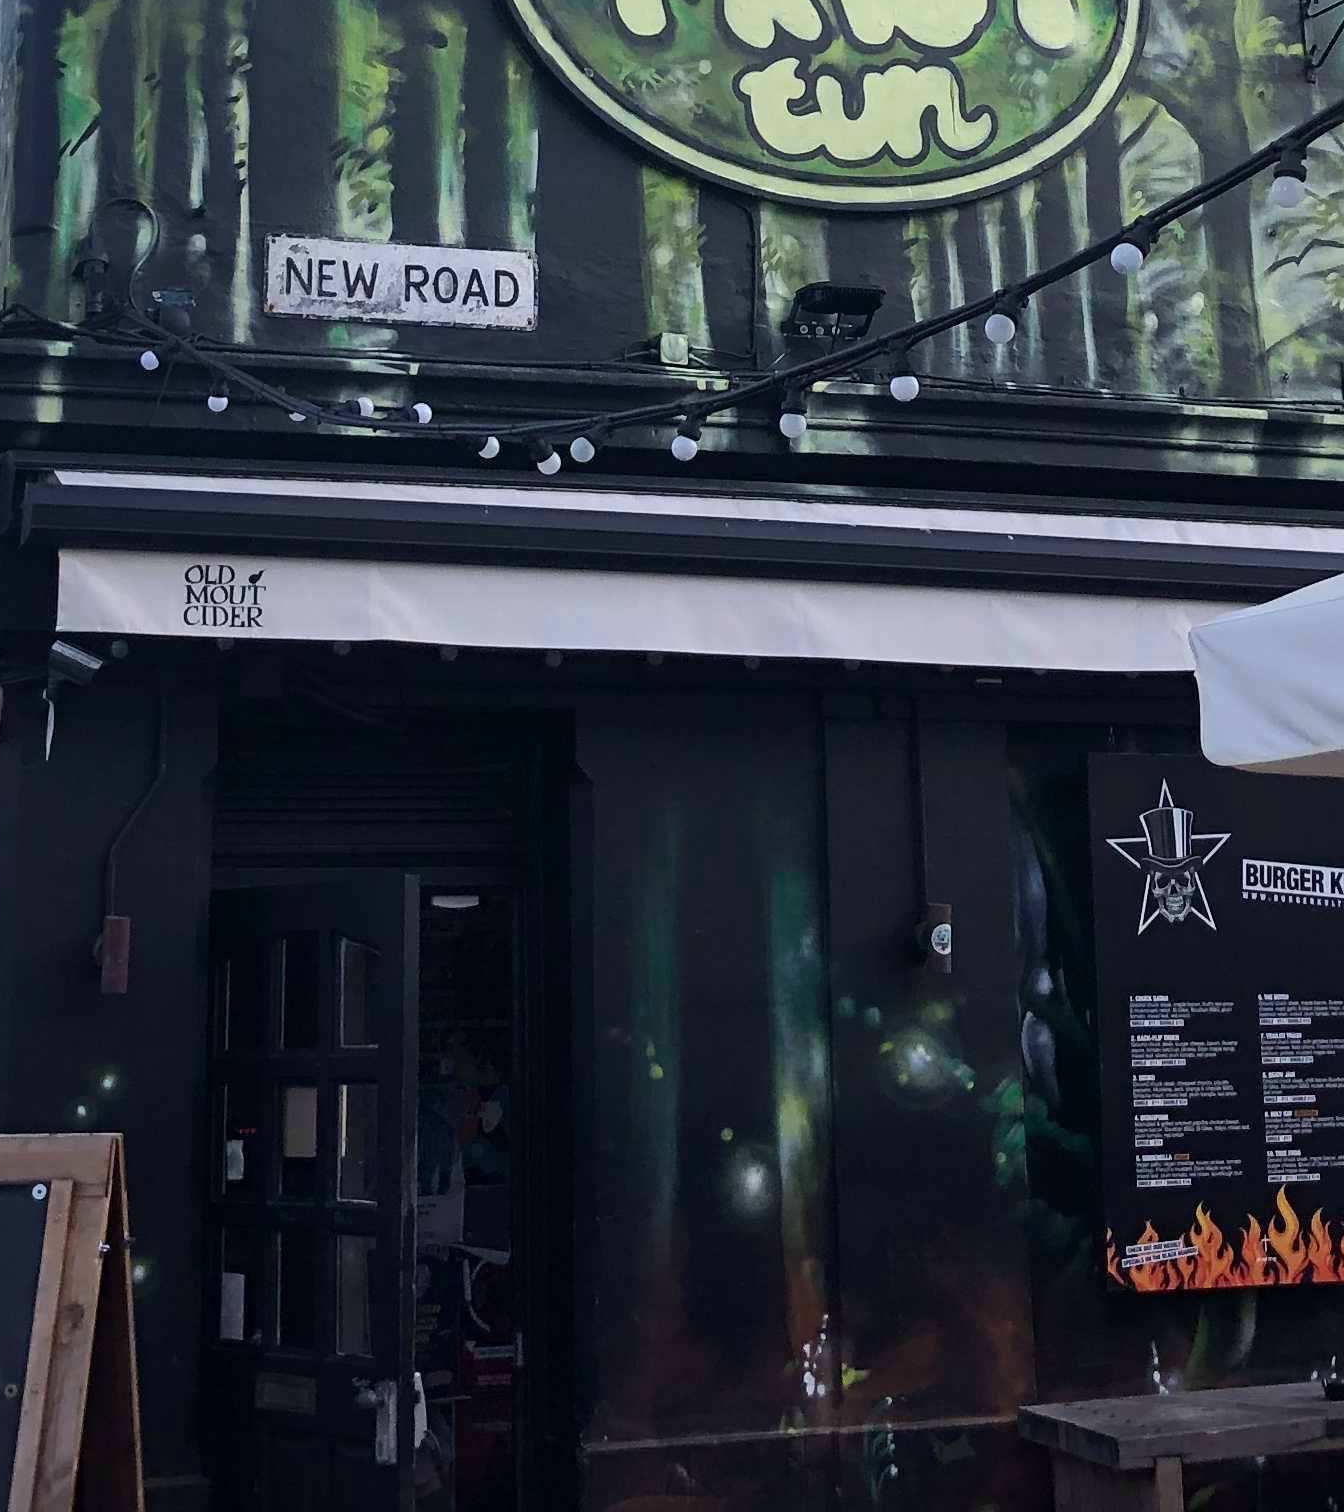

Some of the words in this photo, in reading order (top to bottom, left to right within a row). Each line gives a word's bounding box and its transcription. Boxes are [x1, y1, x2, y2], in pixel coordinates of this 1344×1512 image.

[285, 257, 380, 300] NEW
[404, 264, 521, 309] ROAD
[185, 565, 235, 584] OLD
[185, 585, 267, 605] MOUT
[184, 605, 263, 627] CIDER
[1245, 863, 1324, 894] BURGER
